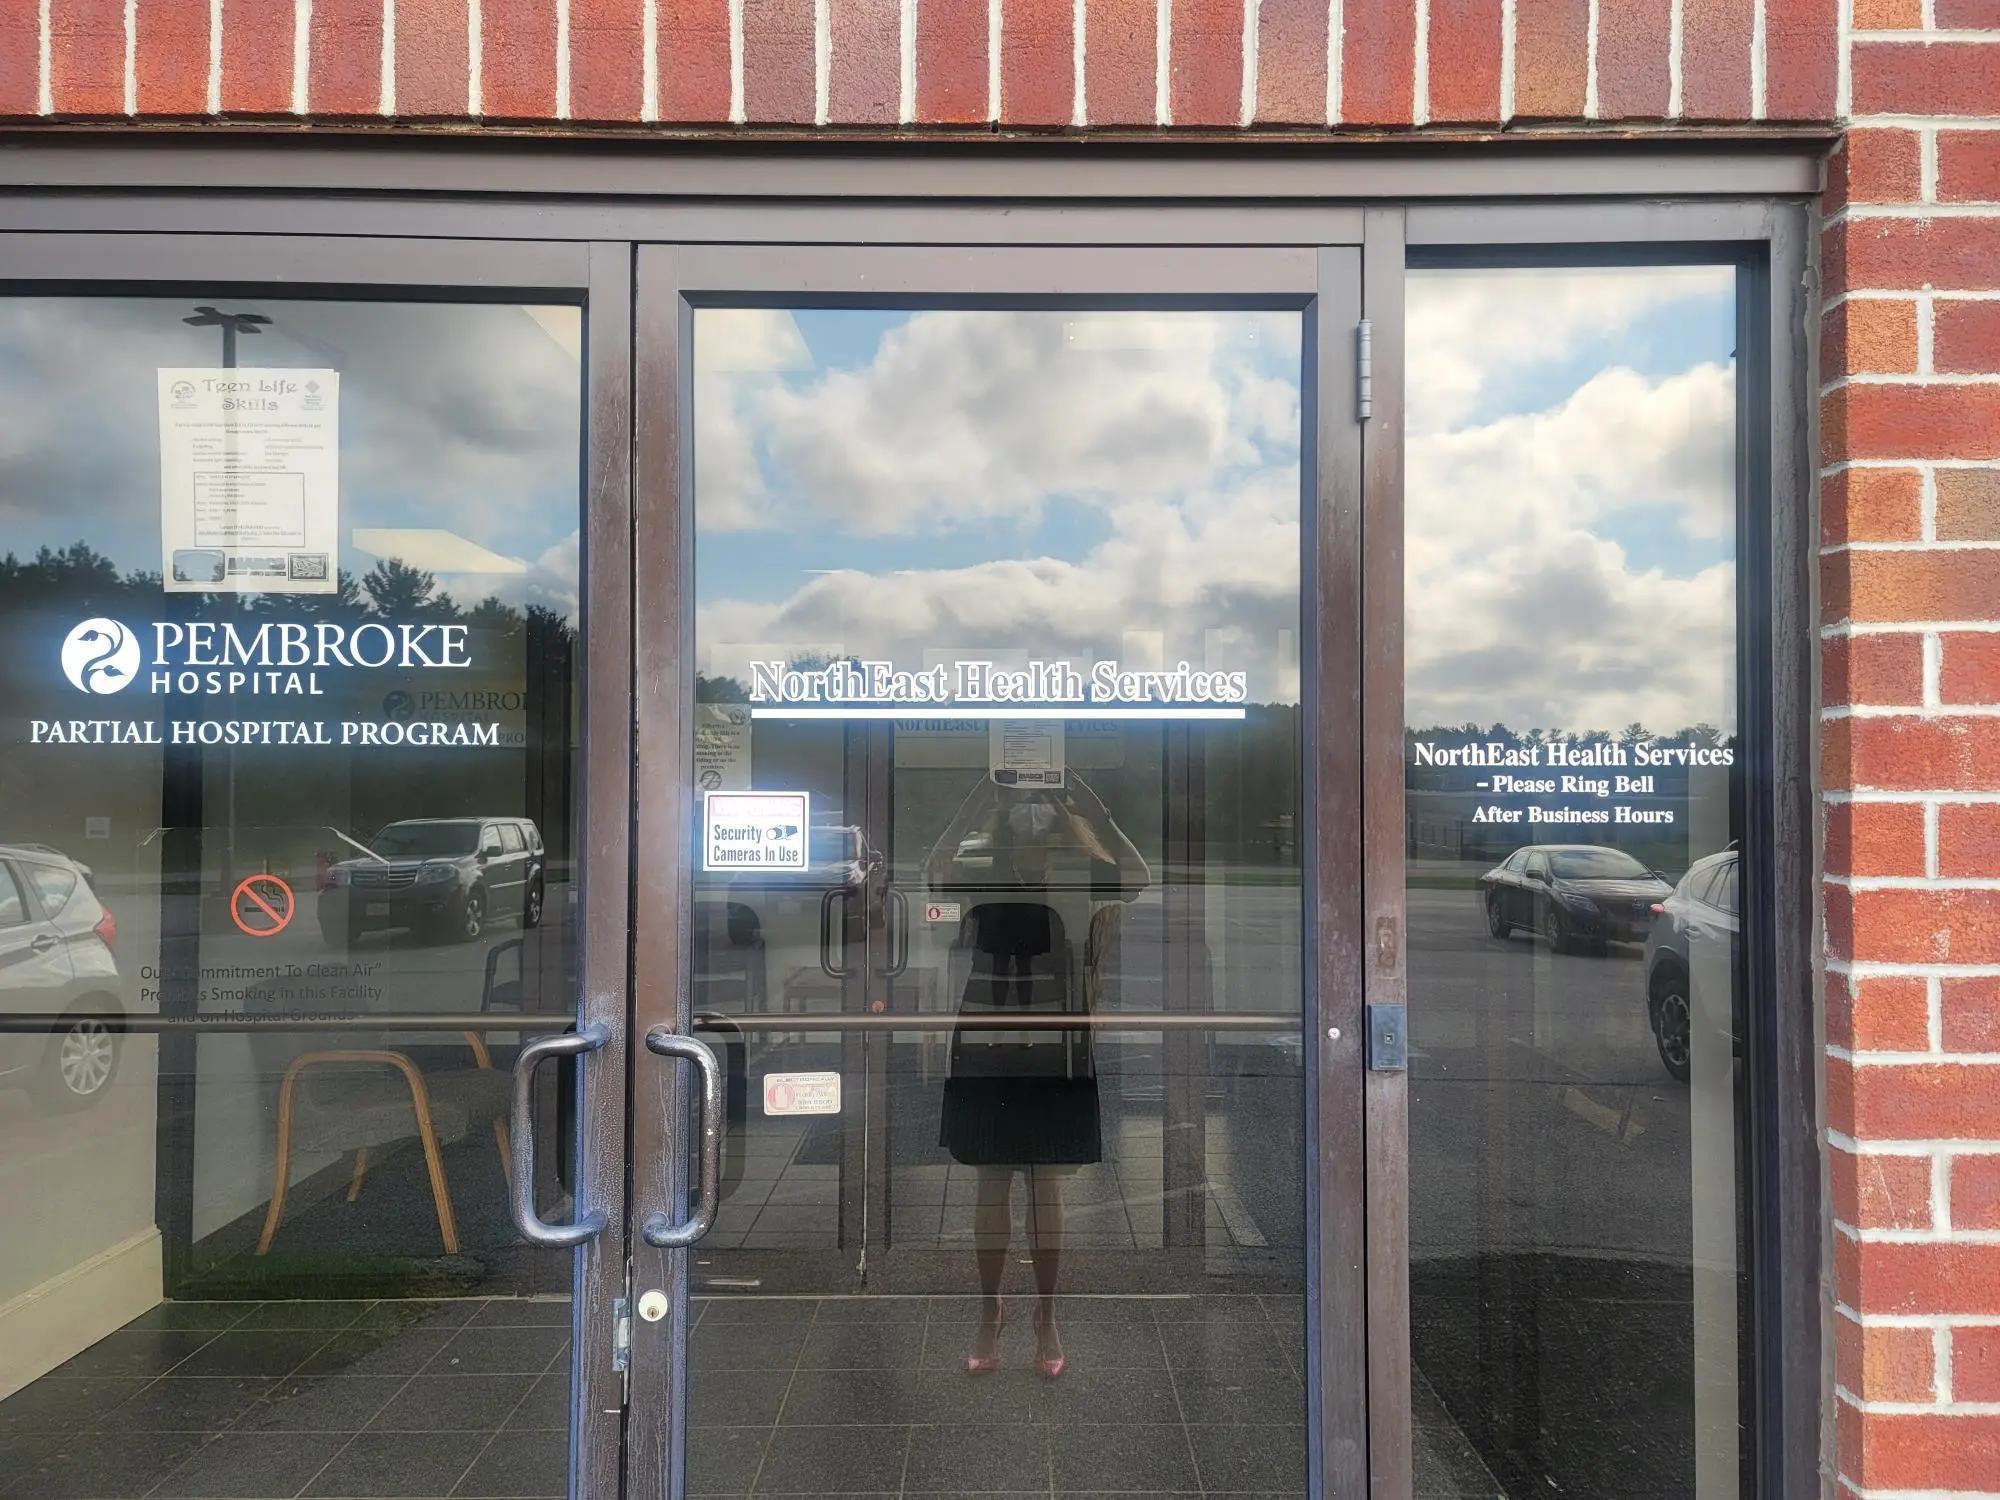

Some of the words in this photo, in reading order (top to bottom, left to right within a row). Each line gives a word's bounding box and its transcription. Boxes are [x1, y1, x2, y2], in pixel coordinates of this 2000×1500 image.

[202, 378, 250, 393] Teen
[258, 379, 299, 395] Life
[222, 397, 279, 411] Skills
[151, 622, 473, 669] PEMBROKE
[151, 670, 324, 695] HOSPITAL
[750, 660, 948, 702] NorthEast
[954, 660, 1085, 702] Health
[1091, 660, 1247, 702] Services
[30, 720, 163, 745] PARTIAL
[170, 720, 332, 745] HOSPITAL
[340, 720, 501, 746] PROGRAM
[1414, 742, 1540, 766] NorthEast
[1546, 742, 1628, 766] Health
[1634, 742, 1734, 767] Services
[1492, 775, 1555, 793] Please
[1560, 775, 1609, 797] Ring
[1615, 775, 1655, 793] Bell
[1471, 806, 1523, 824] After
[1528, 806, 1609, 824] Business
[1614, 806, 1674, 824] Hours
[713, 824, 762, 844] Security
[713, 845, 761, 862] Cameras
[765, 845, 775, 861] In
[779, 845, 798, 862] Use
[285, 964, 302, 977] To
[307, 963, 348, 978] Clean
[211, 986, 276, 1002] Smoking
[280, 986, 295, 1000] in
[299, 985, 327, 1000] this
[330, 985, 383, 1001] Facility
[224, 1009, 285, 1025] Hospital
[290, 1009, 355, 1022] Grounds
